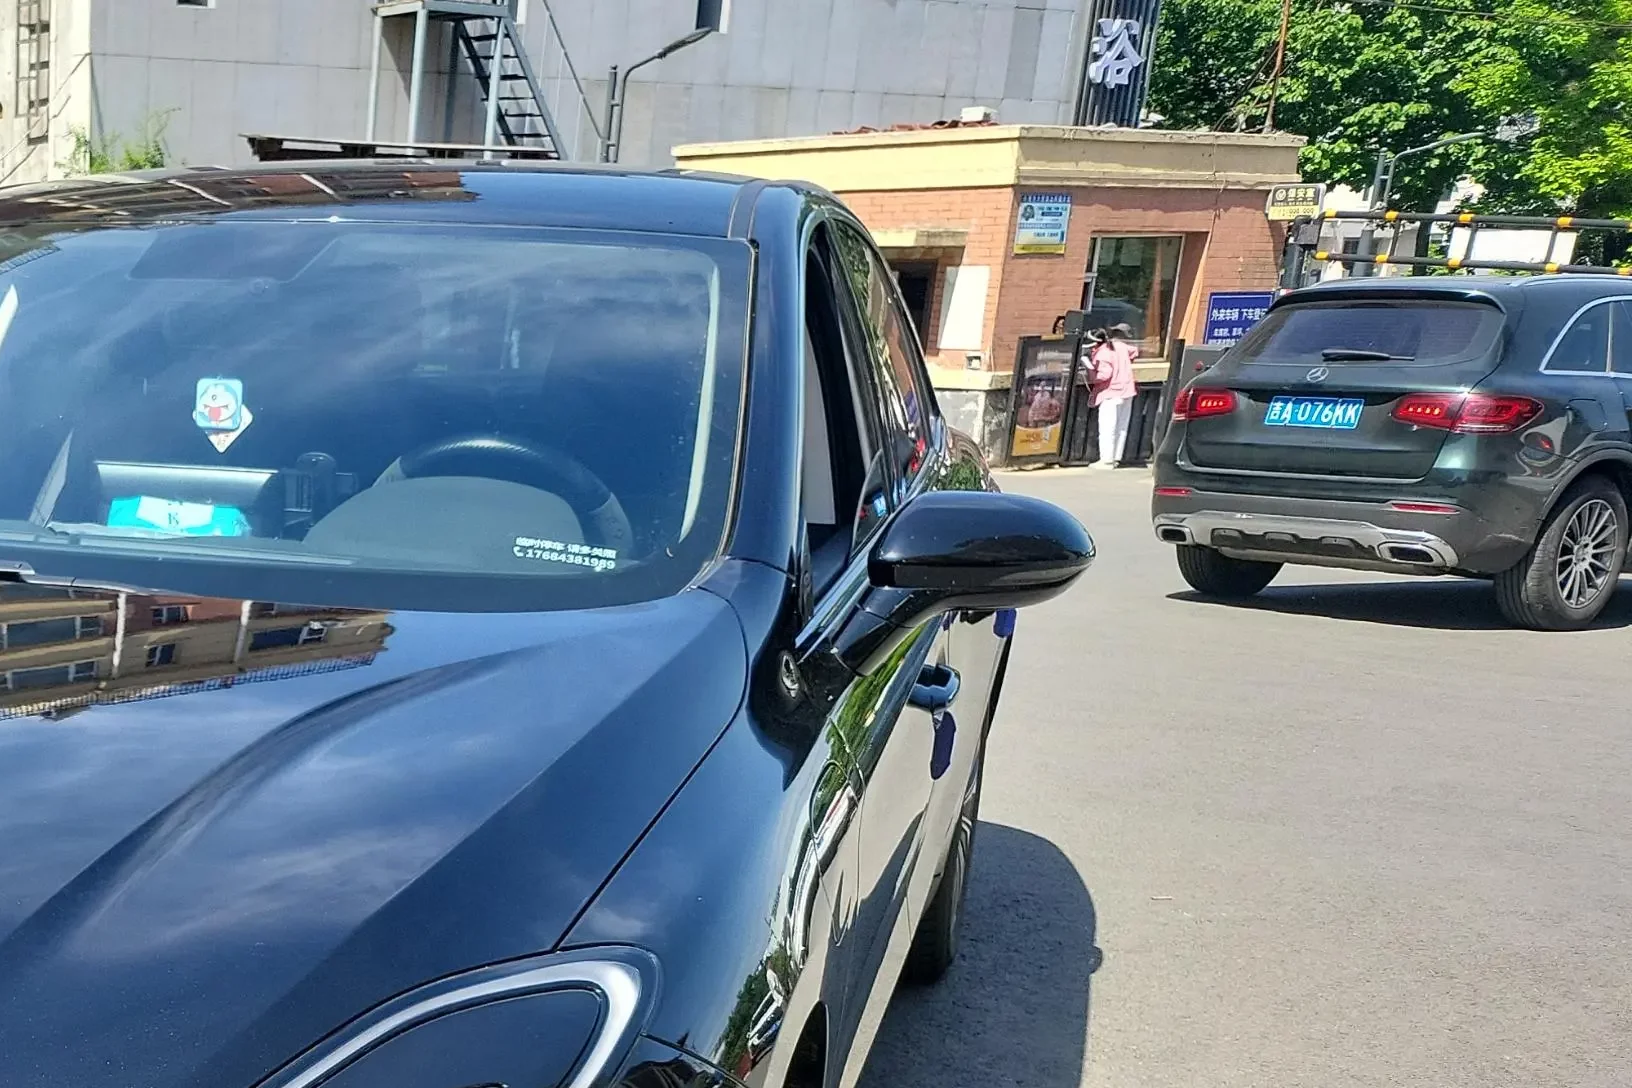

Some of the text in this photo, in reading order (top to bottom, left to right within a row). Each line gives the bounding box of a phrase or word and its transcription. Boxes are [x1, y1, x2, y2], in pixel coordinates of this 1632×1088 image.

[1088, 18, 1145, 89] 浴
[1211, 308, 1239, 321] 外来车辆
[525, 549, 616, 570] 17684381989
[567, 544, 617, 559] 请多关照
